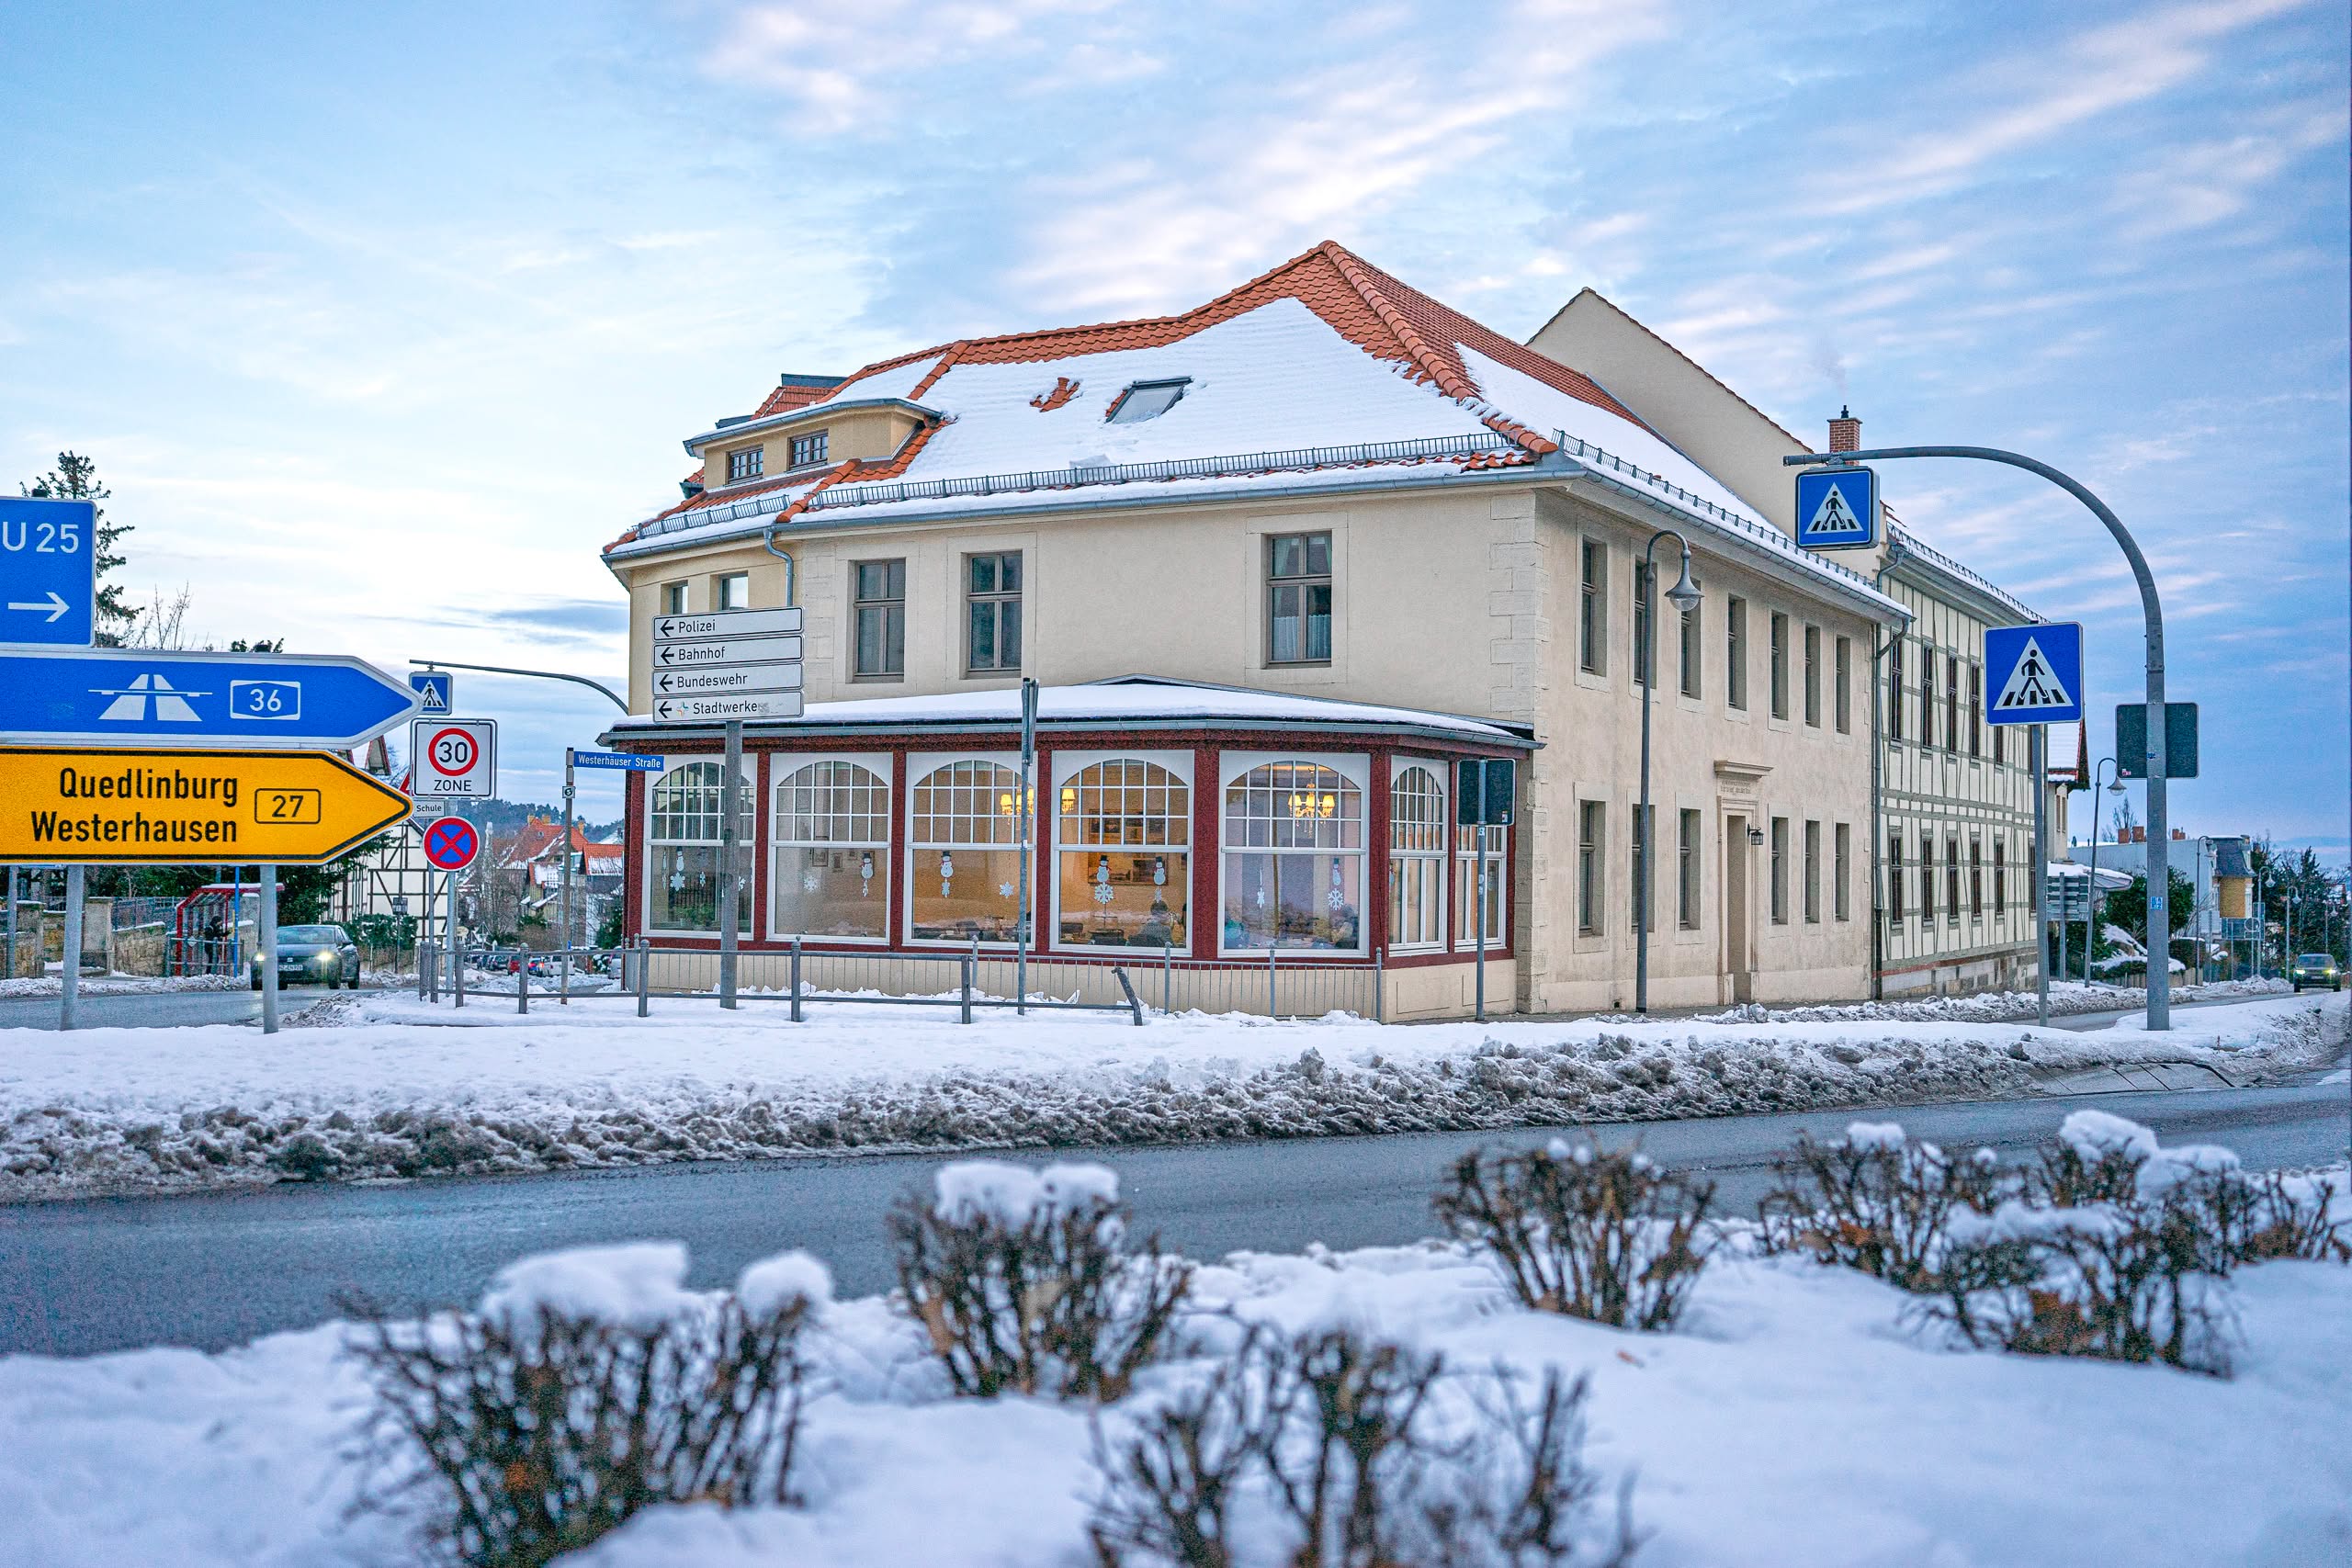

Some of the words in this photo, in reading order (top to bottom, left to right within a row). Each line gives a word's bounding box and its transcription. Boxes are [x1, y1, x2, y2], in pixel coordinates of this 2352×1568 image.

[678, 619, 716, 633] Polizei
[678, 646, 726, 660] Bahnhof
[677, 672, 748, 688] Bundeswehr
[249, 688, 282, 712] 36
[693, 700, 758, 715] Stadtwerke
[438, 741, 468, 763] 30
[578, 753, 632, 767] Westerhäuser
[635, 757, 661, 768] Straße
[60, 767, 238, 807] Quedlinburg
[434, 779, 472, 791] ZONE
[271, 795, 304, 818] 27
[416, 804, 442, 812] Schule
[30, 810, 237, 842] Westerhausen
